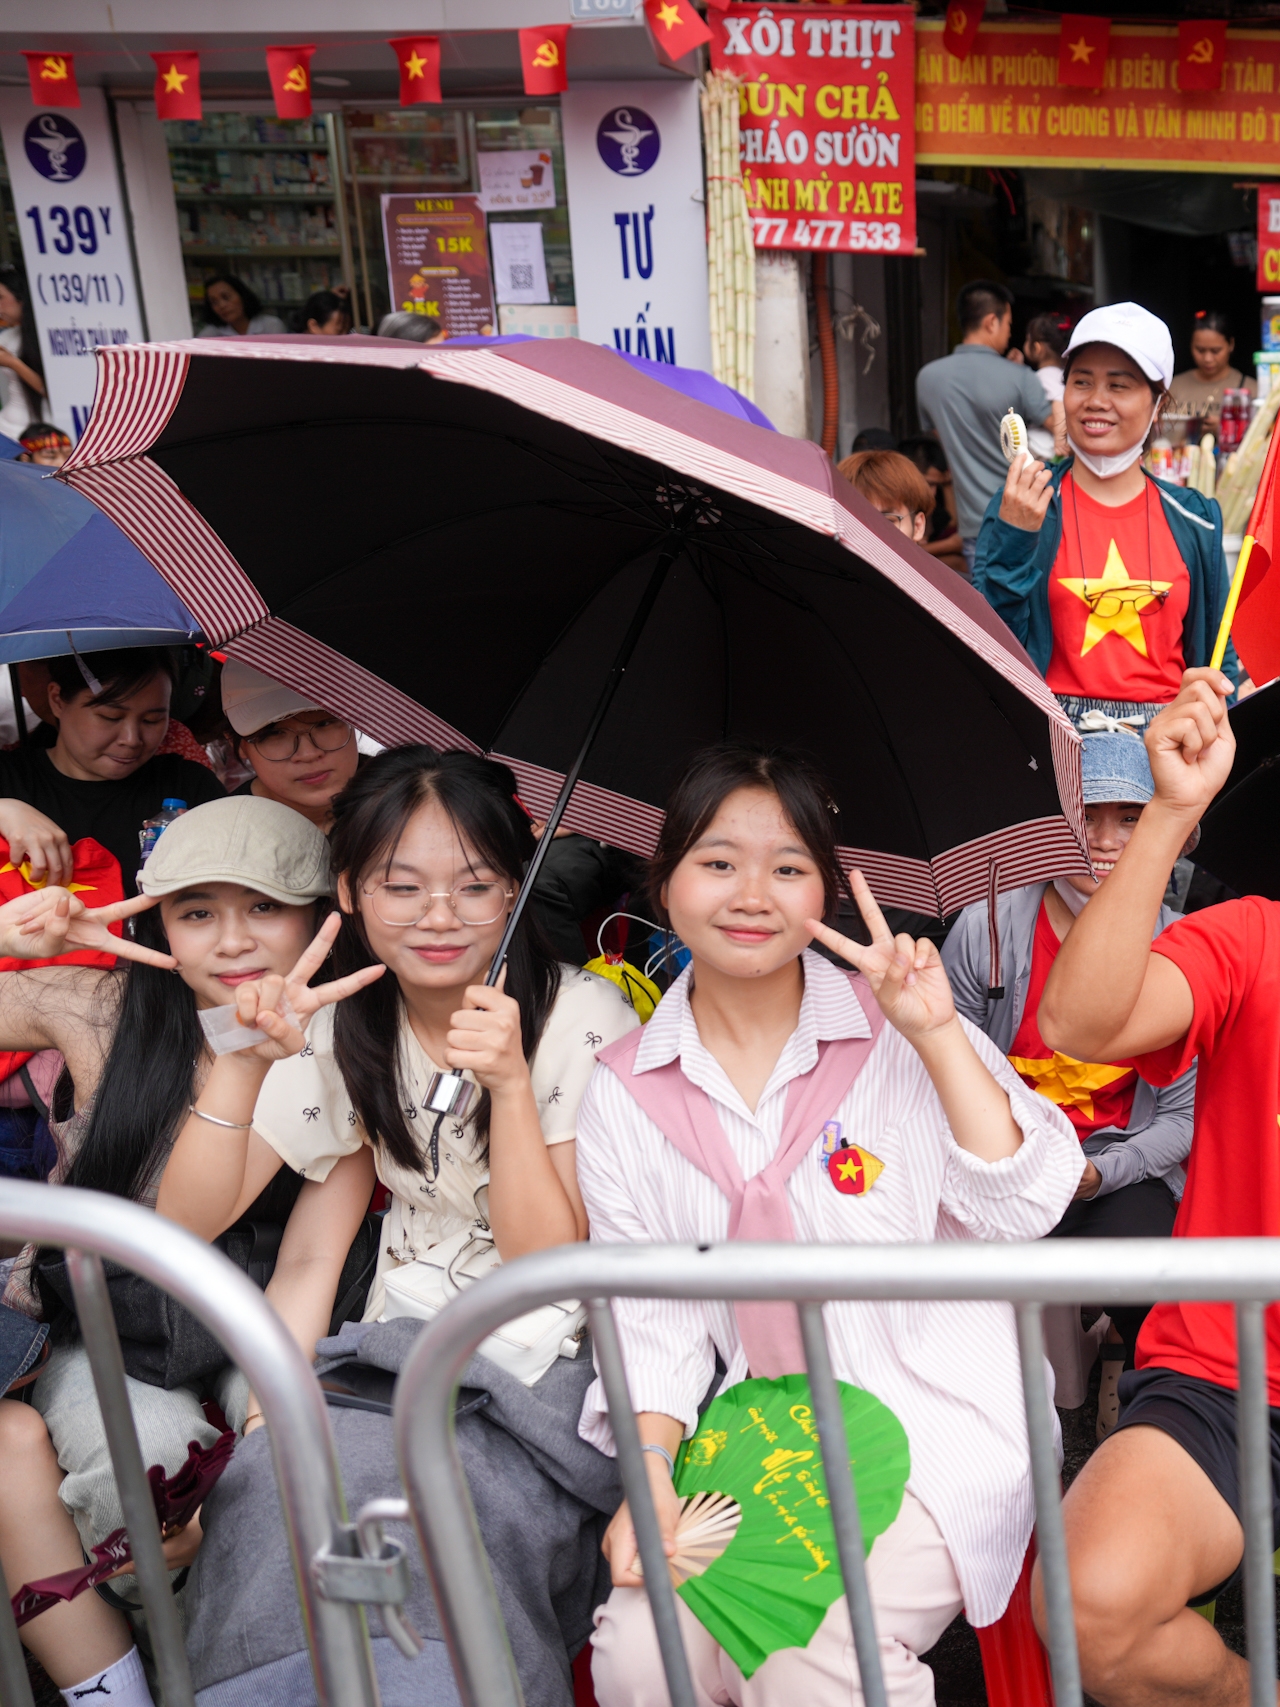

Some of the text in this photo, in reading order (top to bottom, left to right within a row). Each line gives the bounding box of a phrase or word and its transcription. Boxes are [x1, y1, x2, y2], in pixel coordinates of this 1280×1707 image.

[722, 7, 901, 69] XÔI THỊT
[918, 48, 943, 84] ÂN
[993, 48, 1059, 87] PHƯỜN
[1122, 52, 1165, 89] BIÊN
[1233, 57, 1274, 93] TÂM
[738, 72, 807, 118] BÚN
[815, 71, 900, 120] CHẢ
[938, 92, 985, 133] ĐIỂM
[1018, 93, 1042, 134] KỶ
[1115, 101, 1139, 138] VÀ
[1144, 103, 1181, 139] VĂN
[1186, 108, 1236, 141] MINH
[1241, 106, 1266, 142] ĐÔ
[814, 122, 900, 168] SƯỜN
[414, 199, 455, 212] MENU
[743, 168, 904, 215] ÁNH MỲ PATE
[436, 236, 474, 253] 15K
[614, 204, 655, 280] TƯ
[751, 217, 900, 250] 77 477 533
[402, 301, 440, 317] 25K
